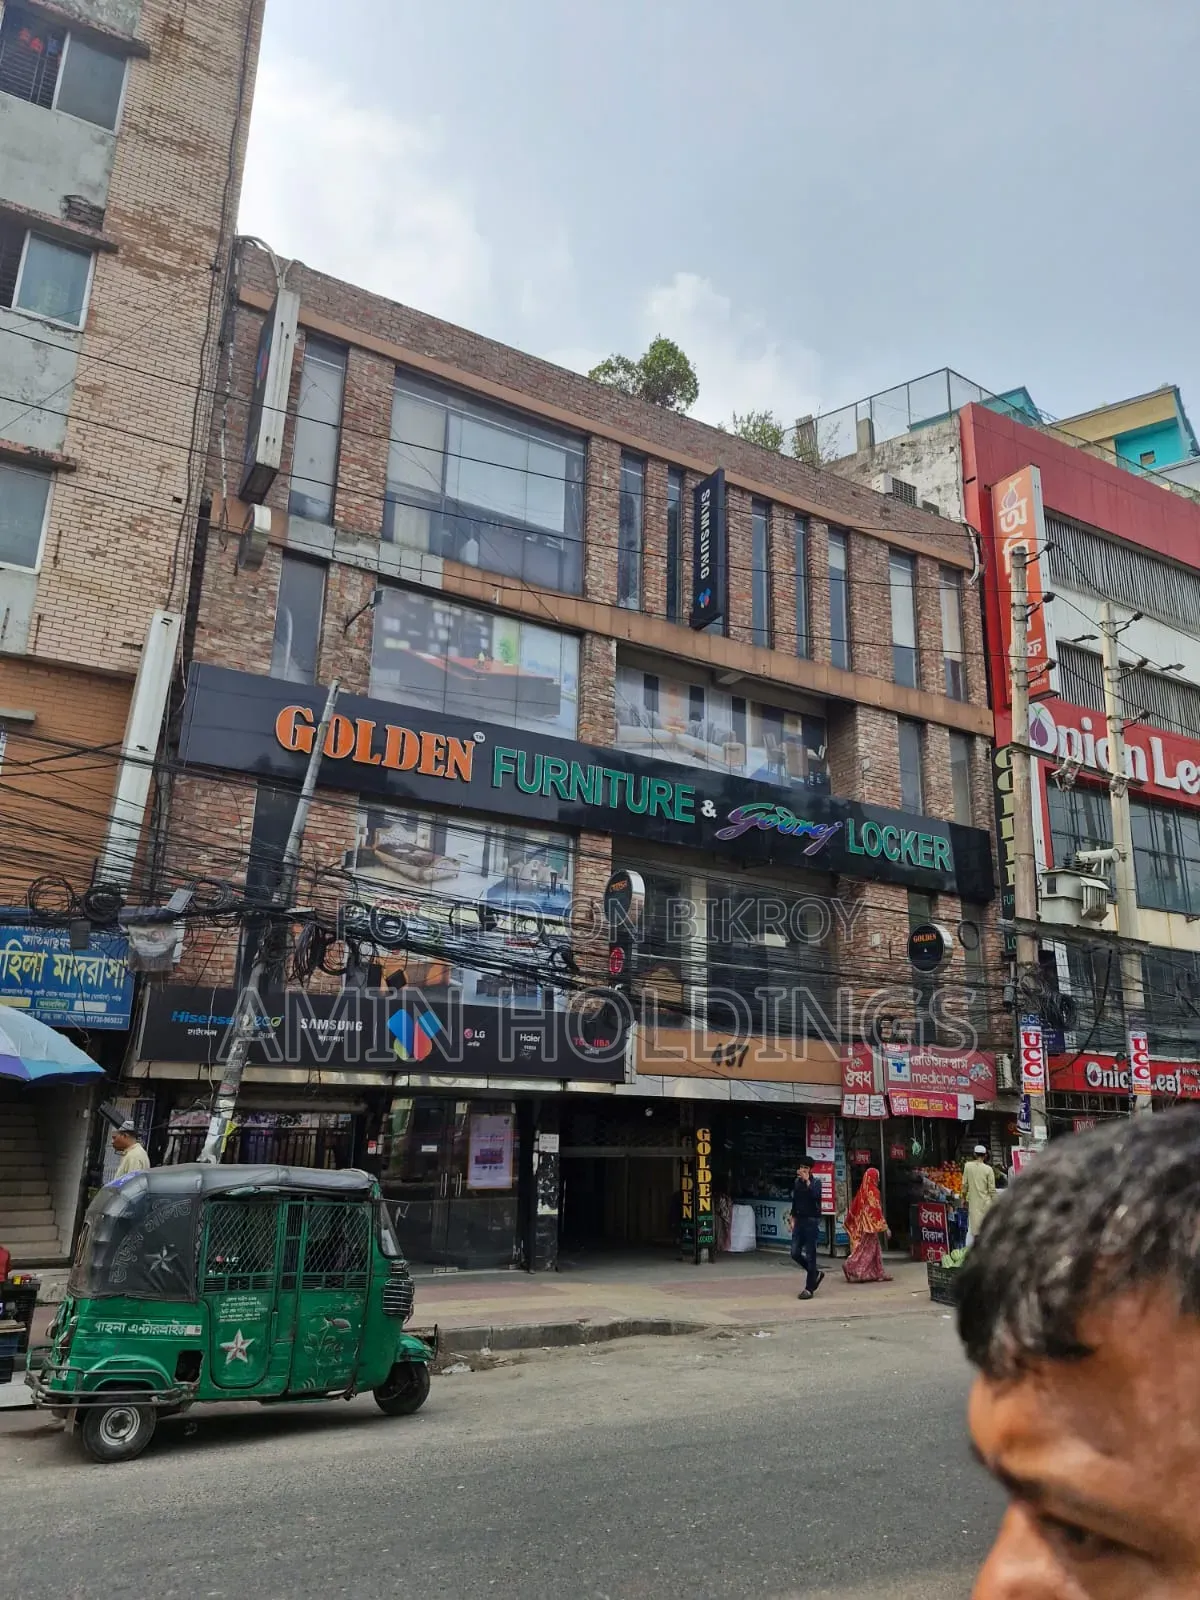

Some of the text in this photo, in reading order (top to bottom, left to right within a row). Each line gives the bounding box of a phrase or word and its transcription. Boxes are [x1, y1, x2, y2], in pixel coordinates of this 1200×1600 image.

[701, 488, 711, 580] SAMSUNG
[275, 705, 476, 782] GOLDEN
[492, 745, 697, 824] FURNITURE
[701, 799, 718, 819] &
[715, 802, 843, 857] Godrej
[846, 817, 953, 873] LOCKER
[913, 932, 937, 943] GOLDEN
[171, 1010, 235, 1025] Hisense
[300, 1018, 363, 1032] SAMSUNG
[474, 1030, 486, 1039] LG
[520, 1033, 541, 1042] Haier
[1022, 1031, 1044, 1078] UCC
[1131, 1038, 1149, 1080] UCC
[911, 1070, 956, 1086] medicine
[696, 1128, 713, 1212] GOLDEN
